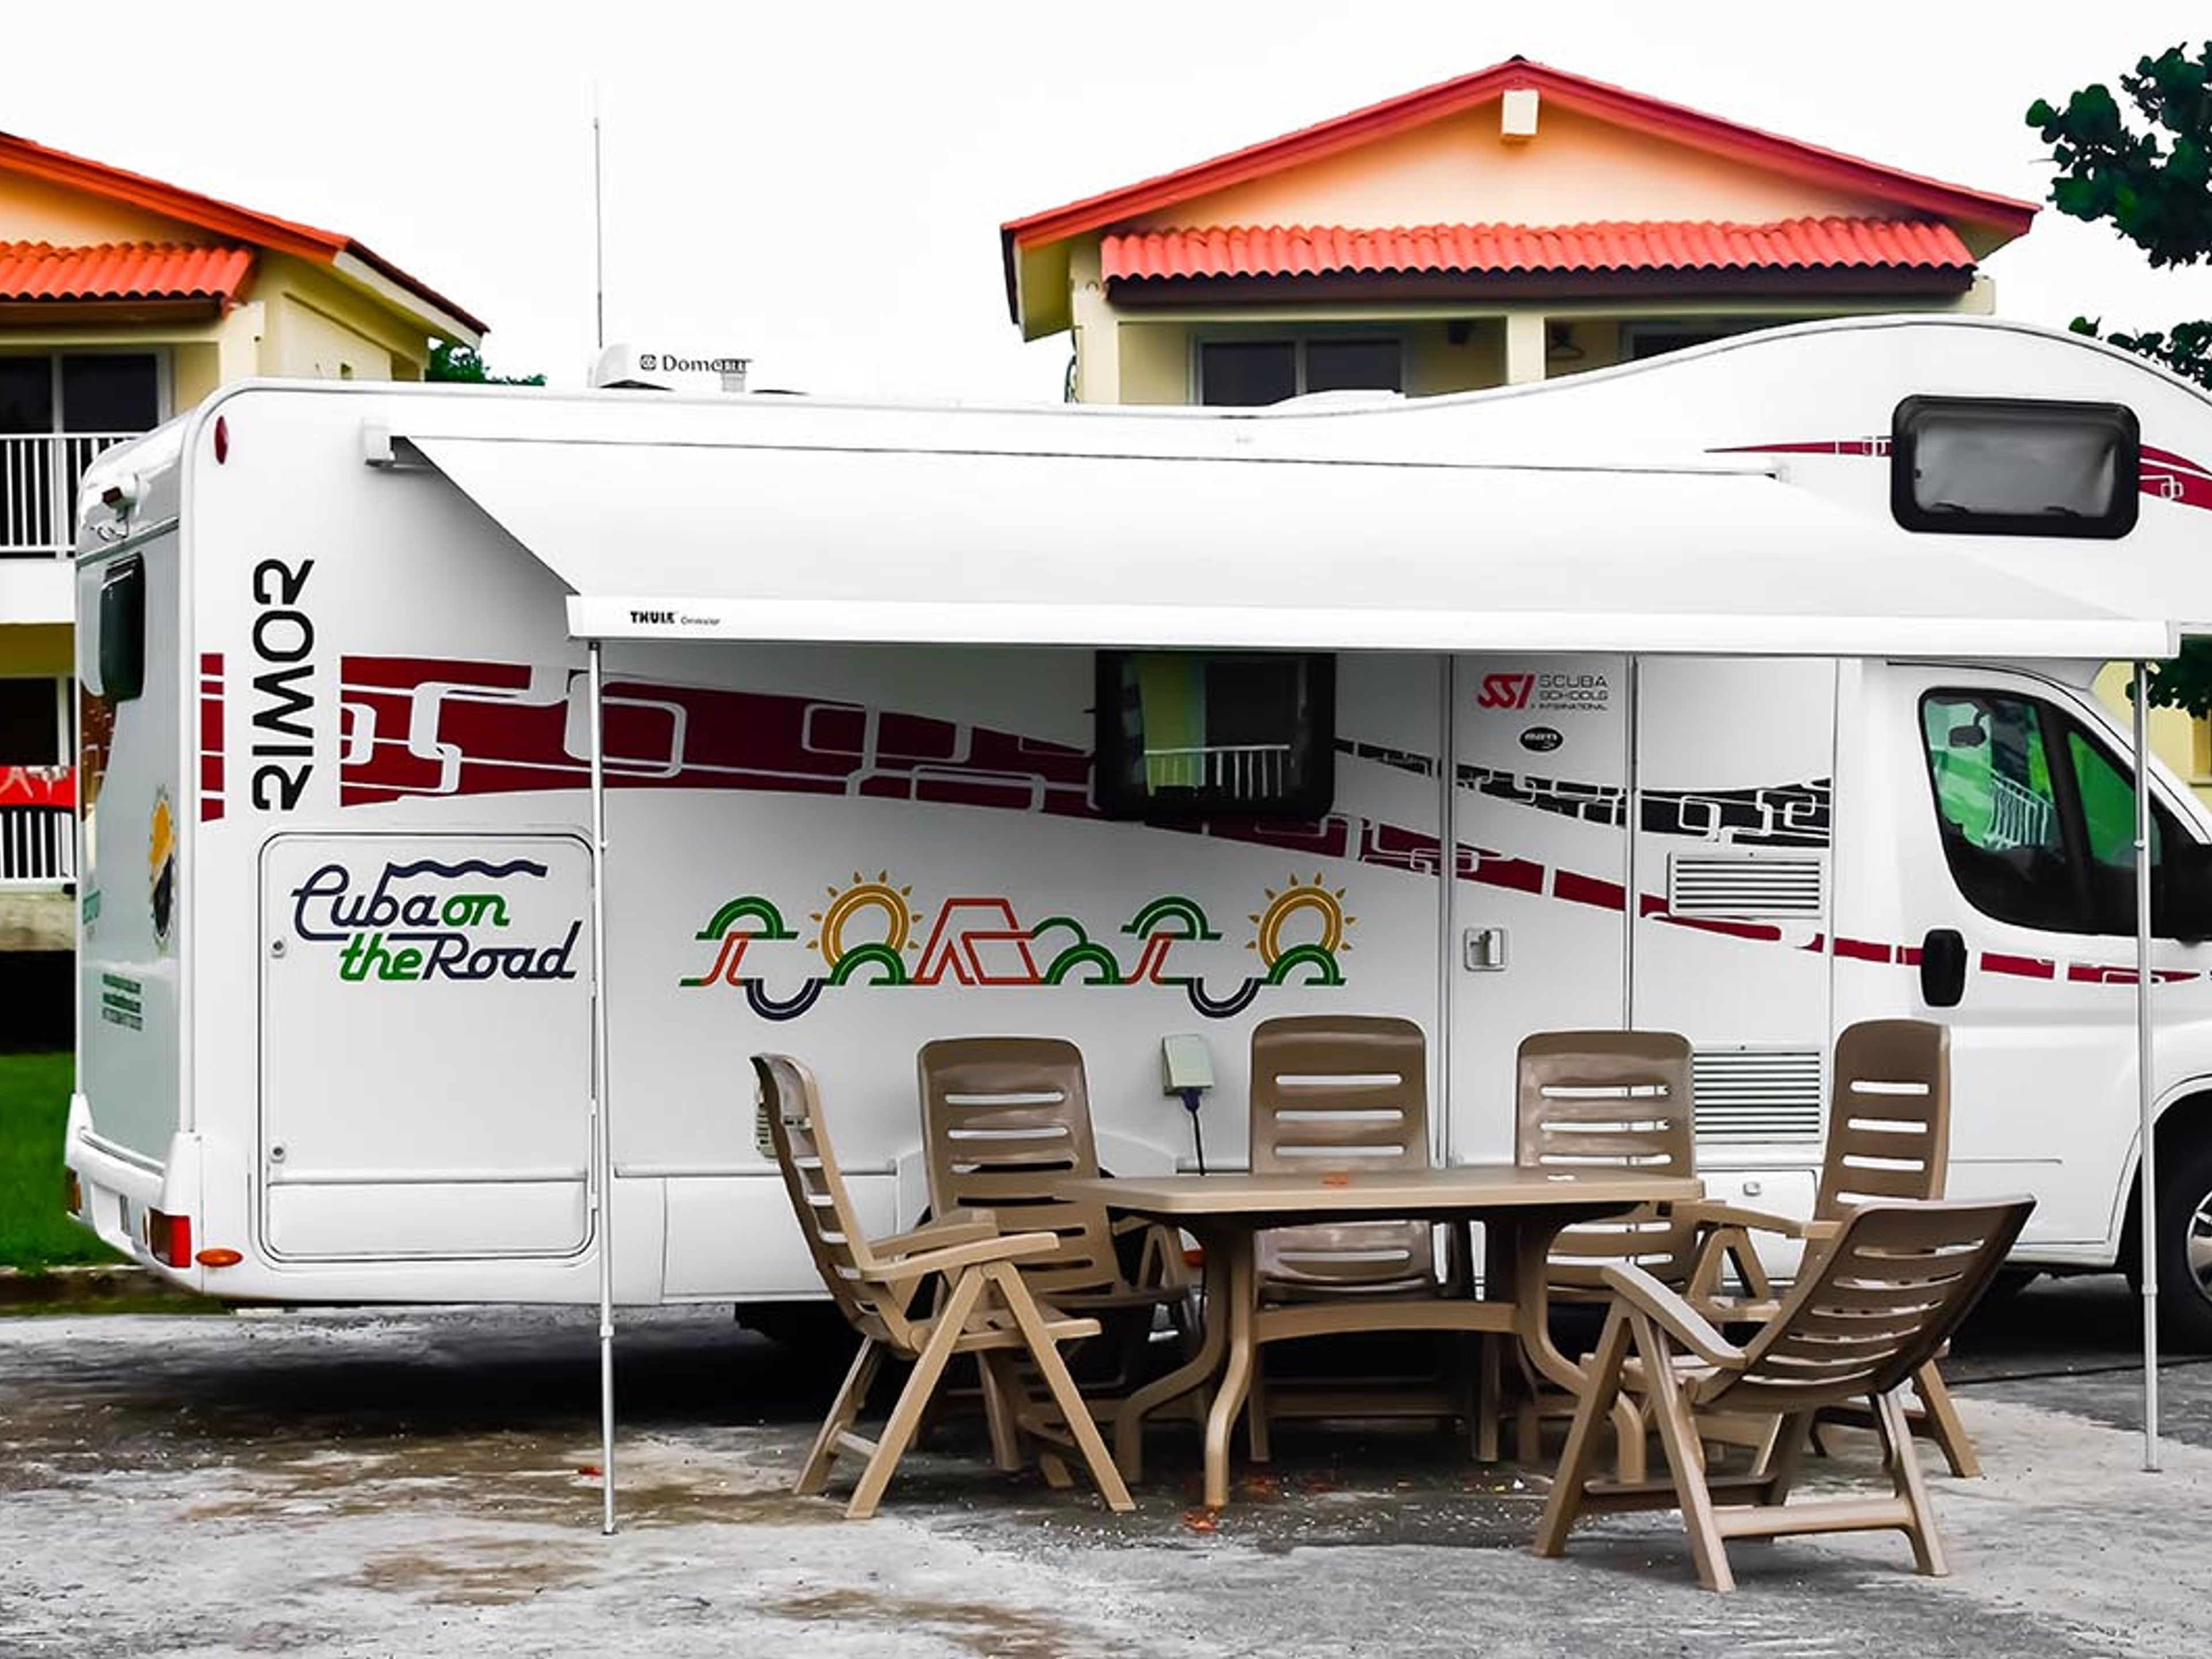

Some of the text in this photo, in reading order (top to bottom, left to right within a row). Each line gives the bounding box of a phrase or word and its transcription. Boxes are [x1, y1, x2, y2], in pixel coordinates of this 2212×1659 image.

[630, 611, 675, 624] THULE
[252, 559, 315, 810] RIMOR
[1478, 673, 1535, 709] SSI
[1539, 675, 1607, 688] SCUBA
[1539, 691, 1608, 700] SCHOOLS
[291, 862, 510, 940] Cuba on
[339, 921, 582, 980] the Road
